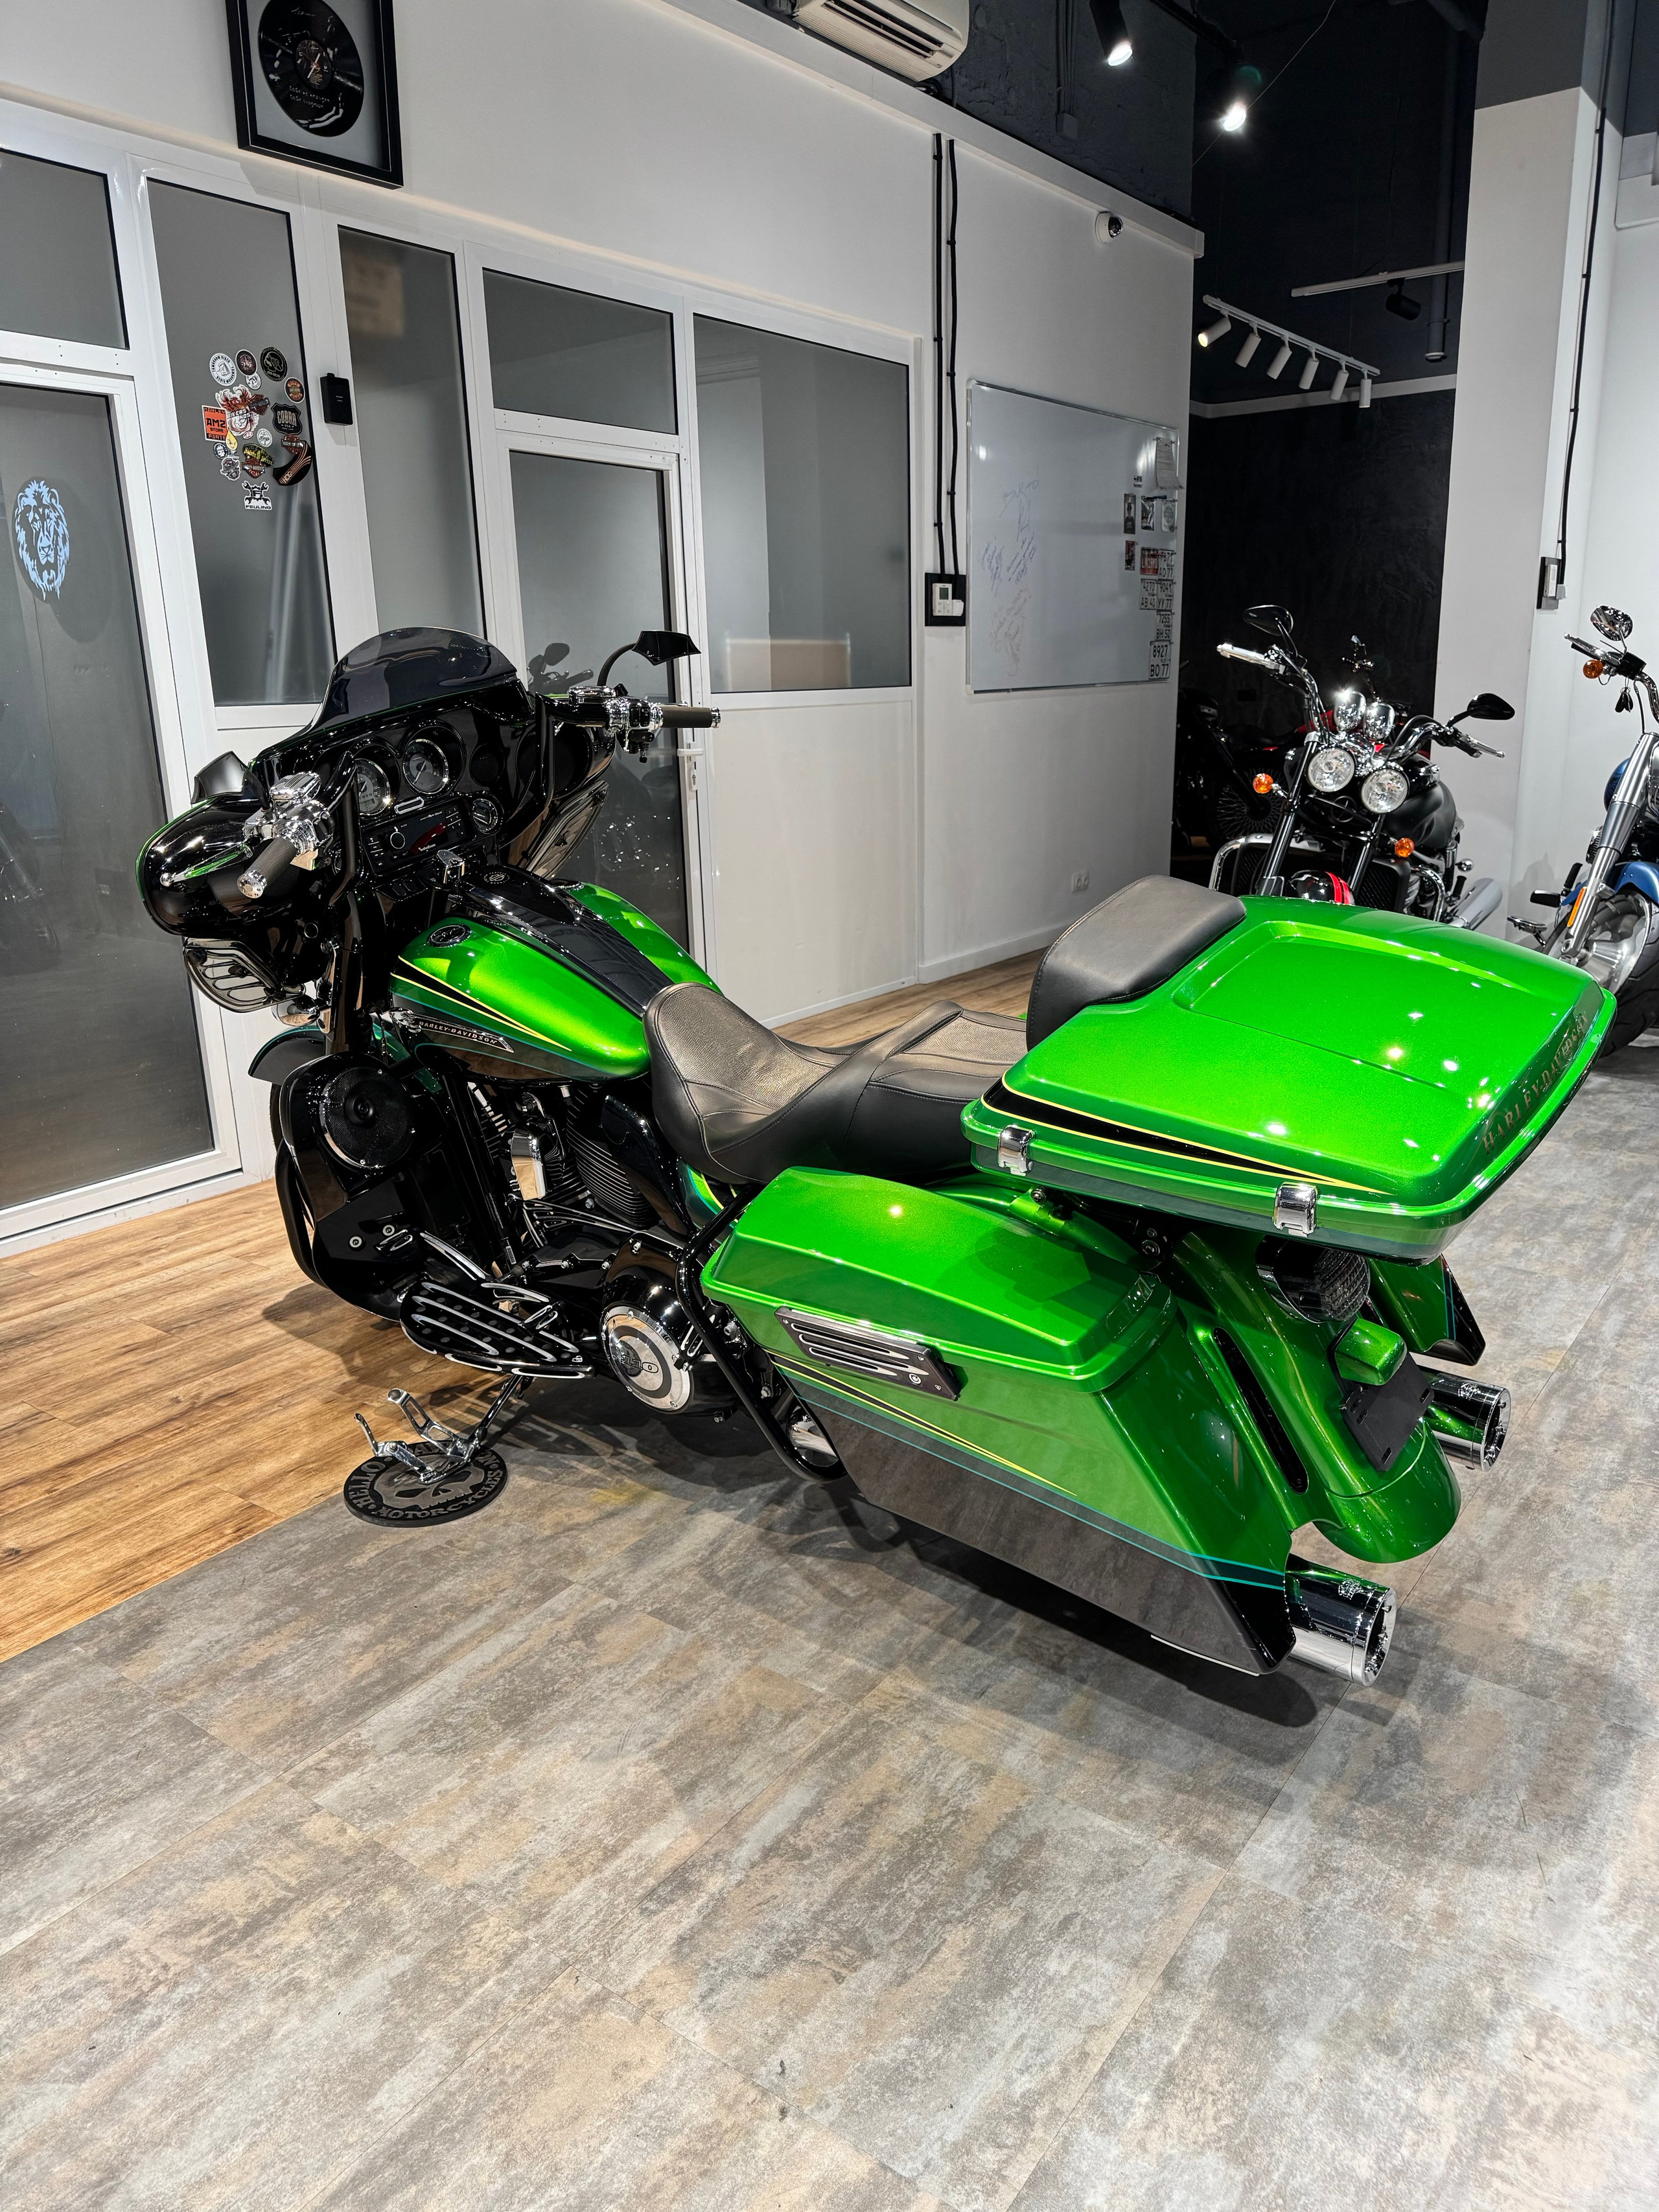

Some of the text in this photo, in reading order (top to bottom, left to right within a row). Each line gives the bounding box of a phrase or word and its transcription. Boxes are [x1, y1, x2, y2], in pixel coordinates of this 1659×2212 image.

[249, 376, 258, 385] 79
[277, 410, 297, 426] COBRA
[1153, 645, 1168, 658] 8927
[1161, 664, 1169, 677] 77
[419, 1021, 498, 1044] HARLEY-DAVIDSON
[372, 1469, 504, 1519] MOTORCYCLES
